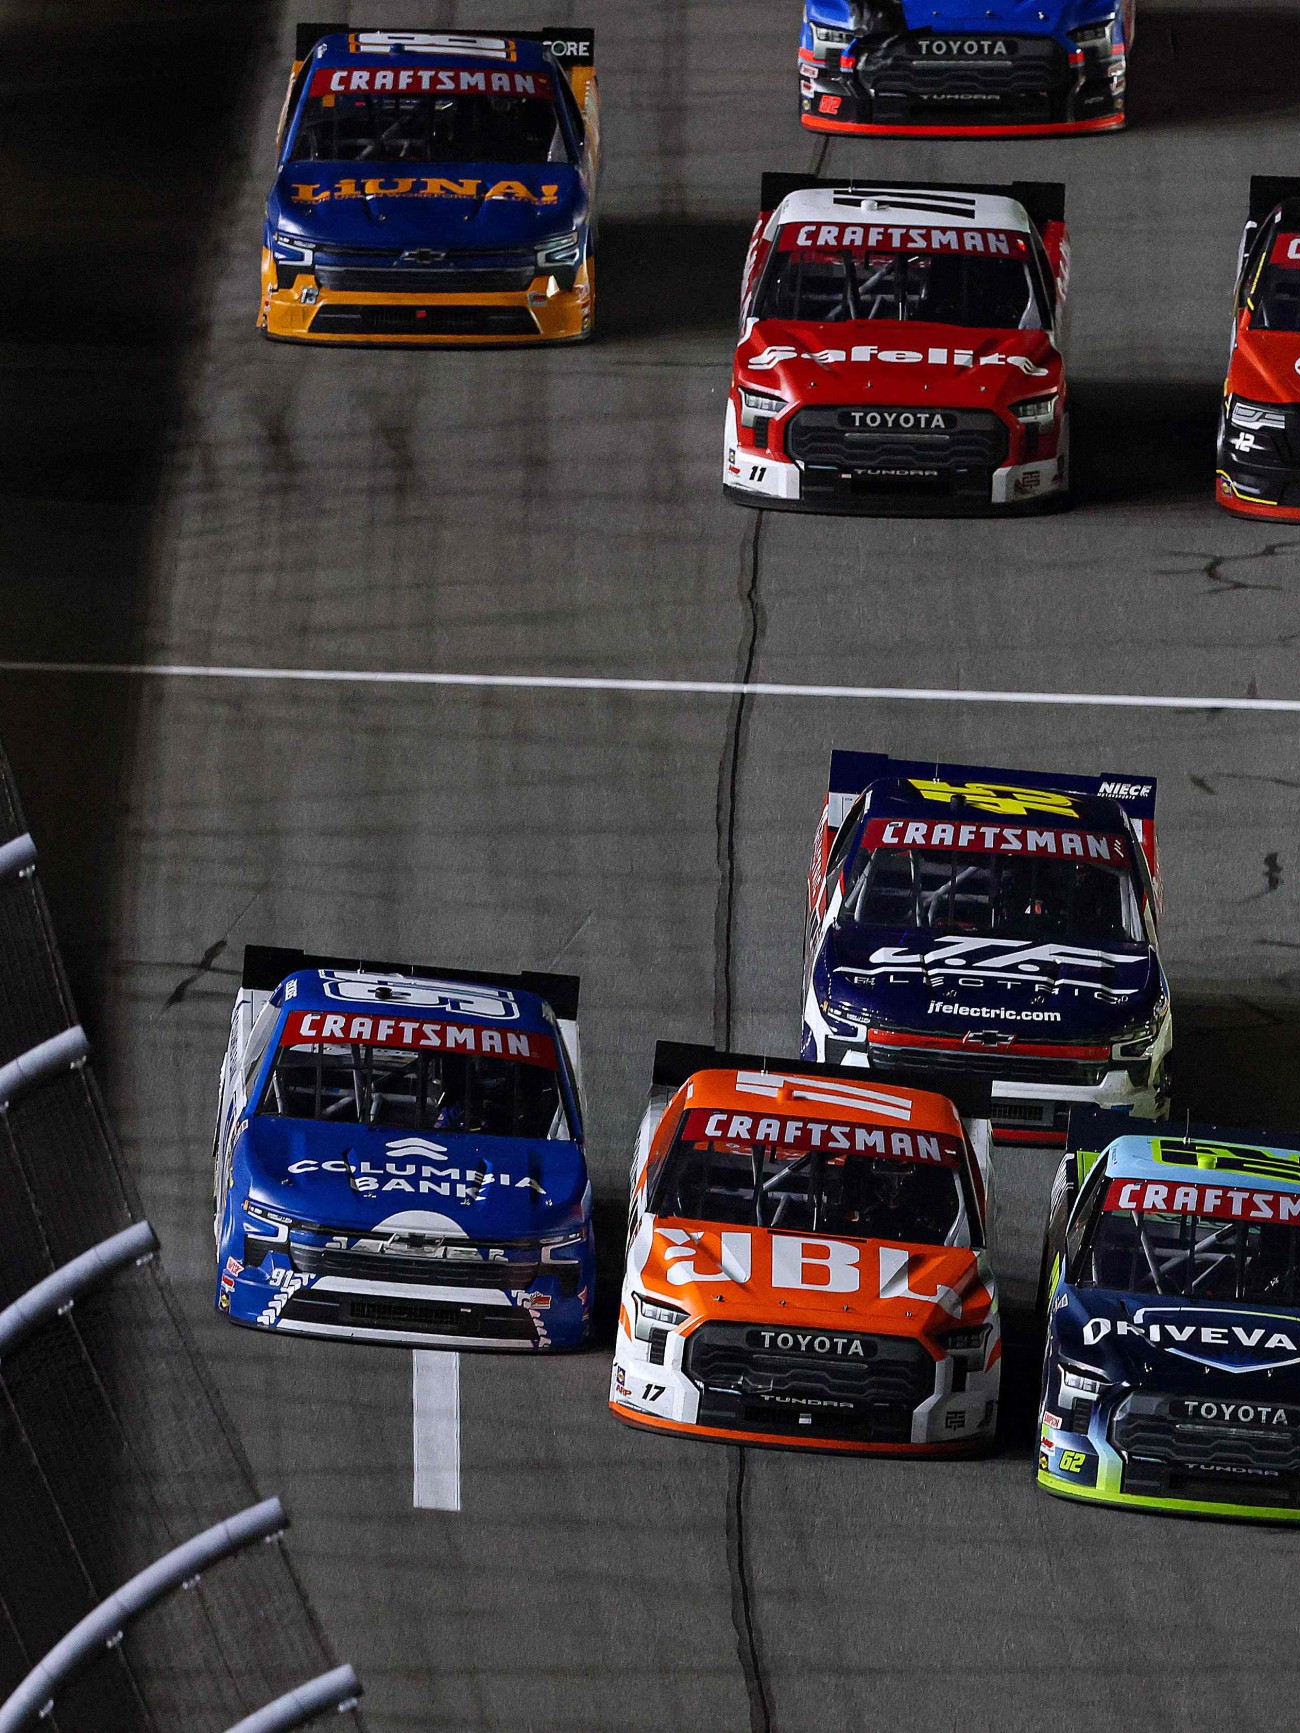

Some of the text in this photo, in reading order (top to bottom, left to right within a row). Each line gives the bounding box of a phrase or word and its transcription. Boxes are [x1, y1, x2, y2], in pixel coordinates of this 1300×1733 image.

[543, 40, 590, 56] ORE
[918, 40, 1007, 55] TOYOTA
[330, 70, 535, 94] CRAFTSMAN
[796, 225, 1010, 255] CRAFTSMAN
[747, 345, 1049, 377] Safelite
[851, 412, 945, 429] TOYOTA
[1235, 432, 1255, 453] 12
[749, 465, 767, 482] 11
[854, 468, 938, 476] TUNDRA
[1099, 781, 1152, 797] NIECE
[881, 821, 1111, 860] CRAFTSMAN
[927, 1001, 1062, 1022] jfelectric.com
[300, 1013, 532, 1058] CRAFTSMAN
[704, 1113, 942, 1162] CRAFTSMAN
[287, 1159, 547, 1196] COLUMBIA
[350, 1176, 487, 1202] BANK
[270, 1267, 294, 1288] 91
[760, 1331, 864, 1357] TOYOTA
[642, 1383, 667, 1402] 17
[760, 1394, 854, 1409] TUNDRA
[1184, 1400, 1288, 1426] TOYOTA
[1059, 1450, 1086, 1474] 62
[1185, 1463, 1279, 1476] TUNDRA
